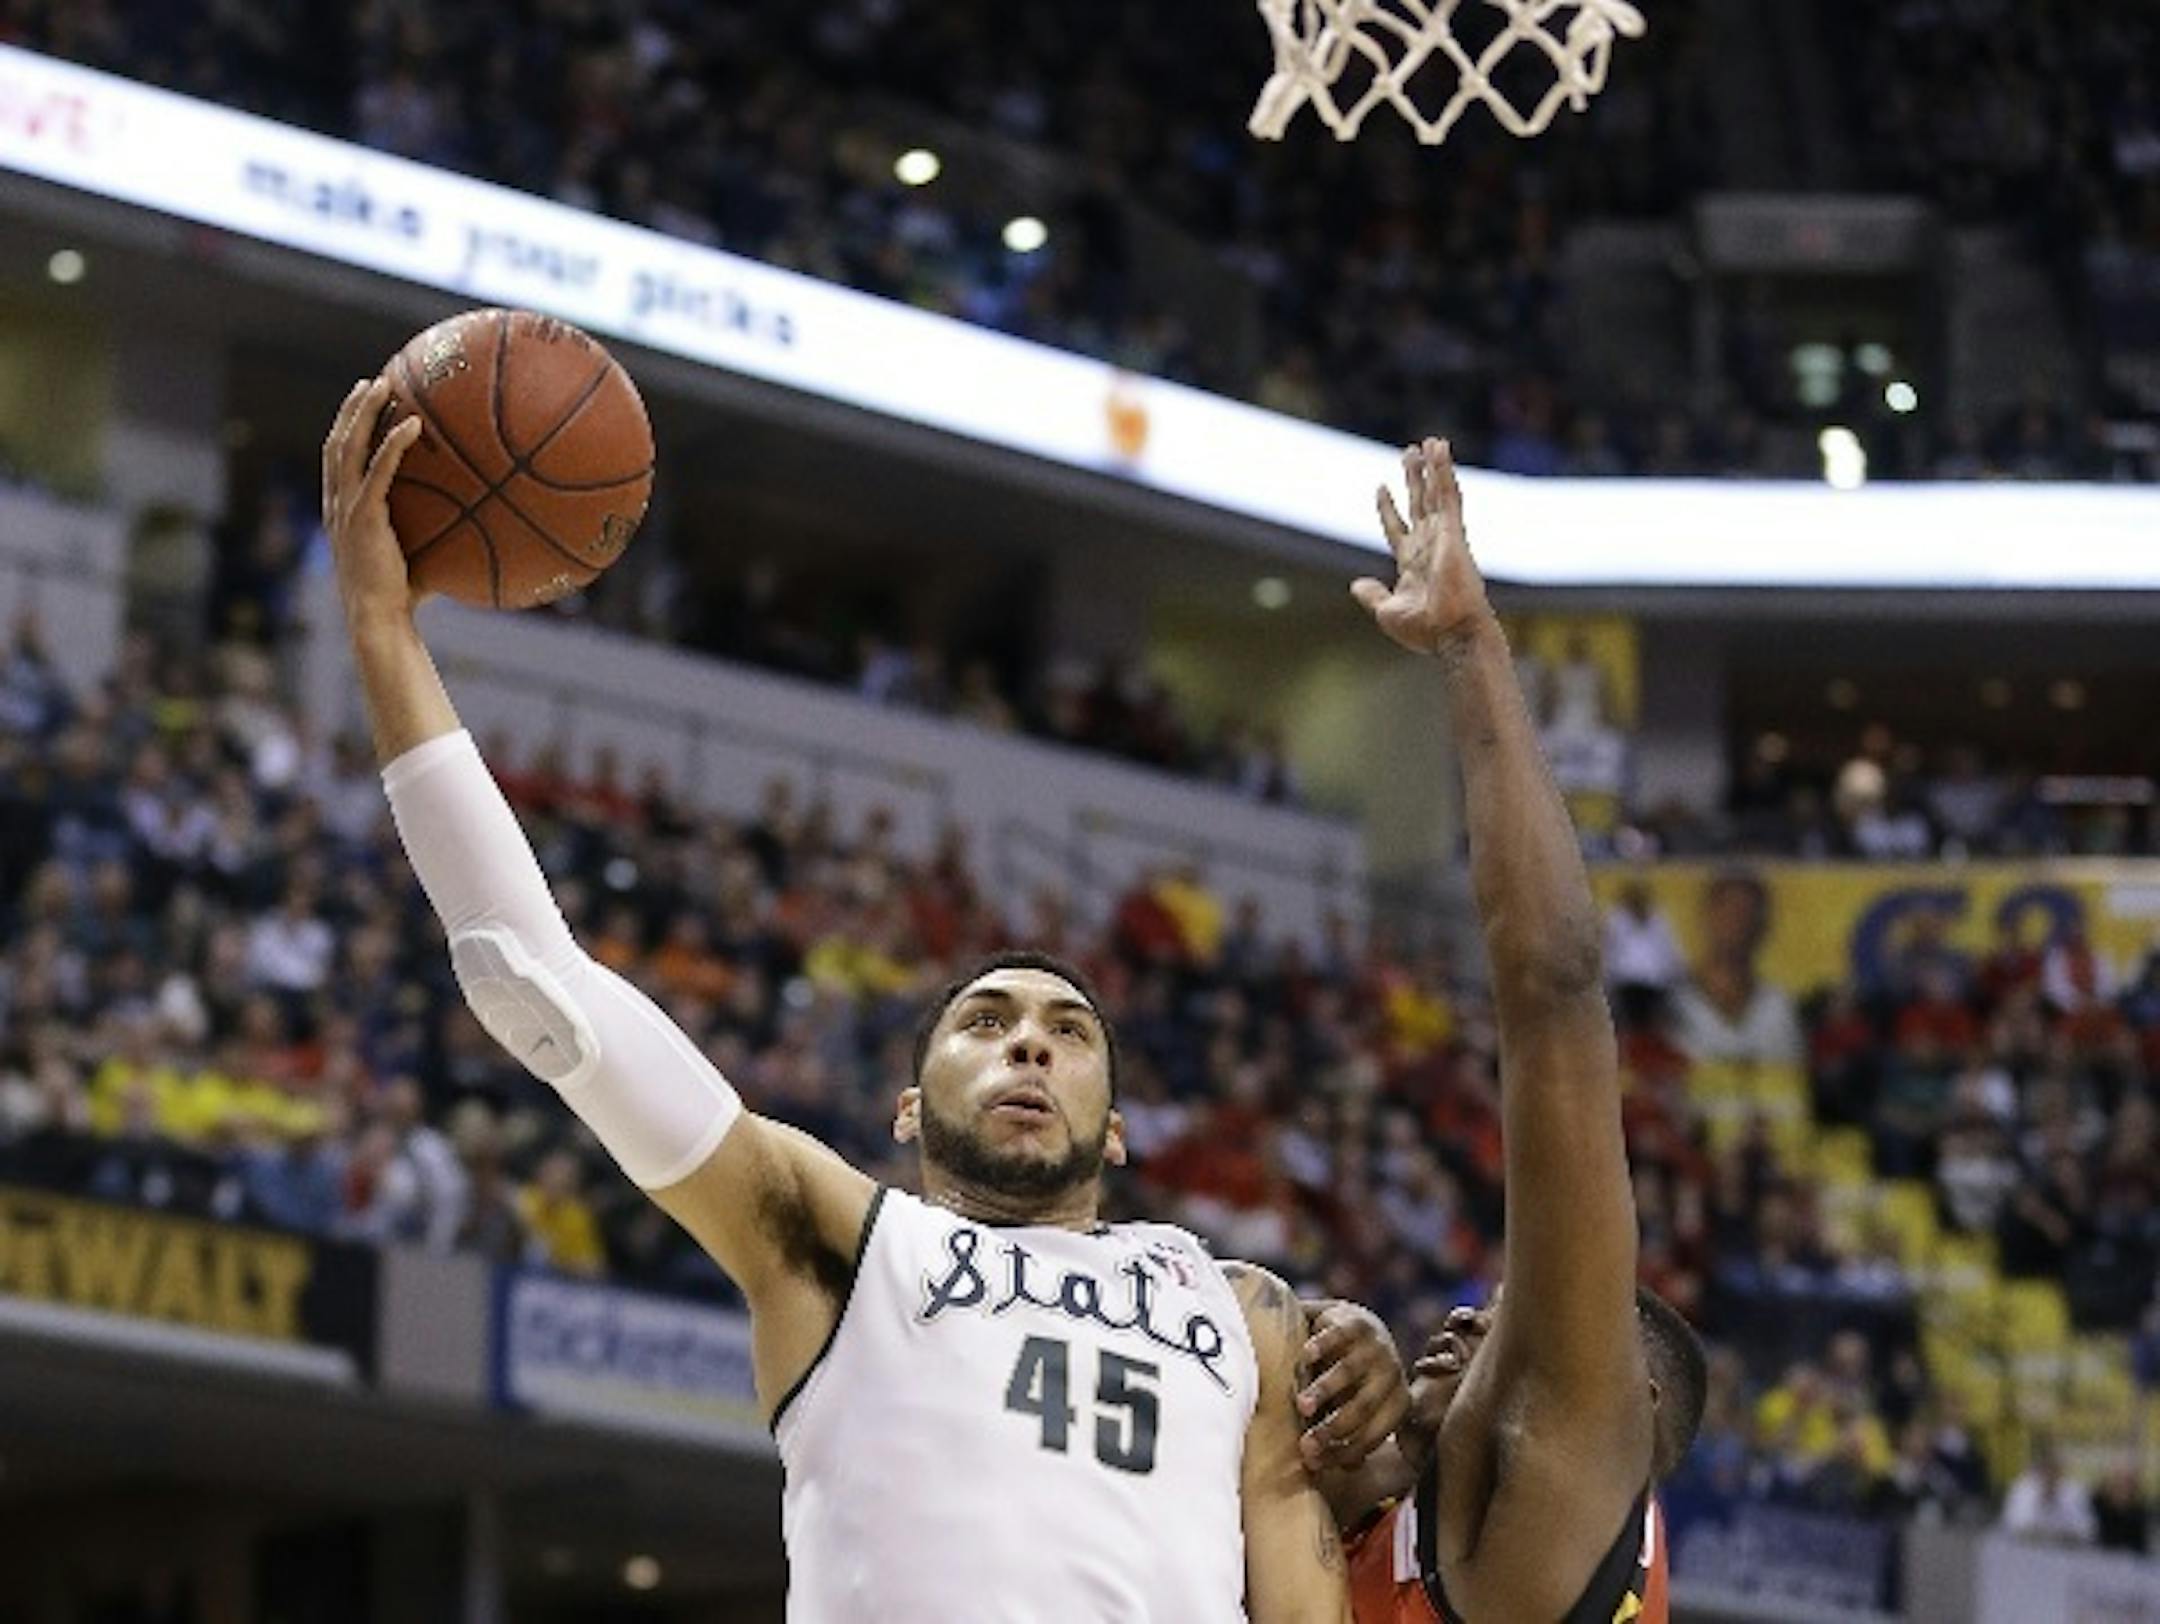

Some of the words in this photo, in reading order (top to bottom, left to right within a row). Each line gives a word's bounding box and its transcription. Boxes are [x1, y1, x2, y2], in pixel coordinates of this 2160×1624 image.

[241, 156, 423, 241] make
[456, 222, 601, 290] your
[626, 266, 798, 350] picks
[916, 1228, 1234, 1396] State
[1003, 1335, 1161, 1475] 45
